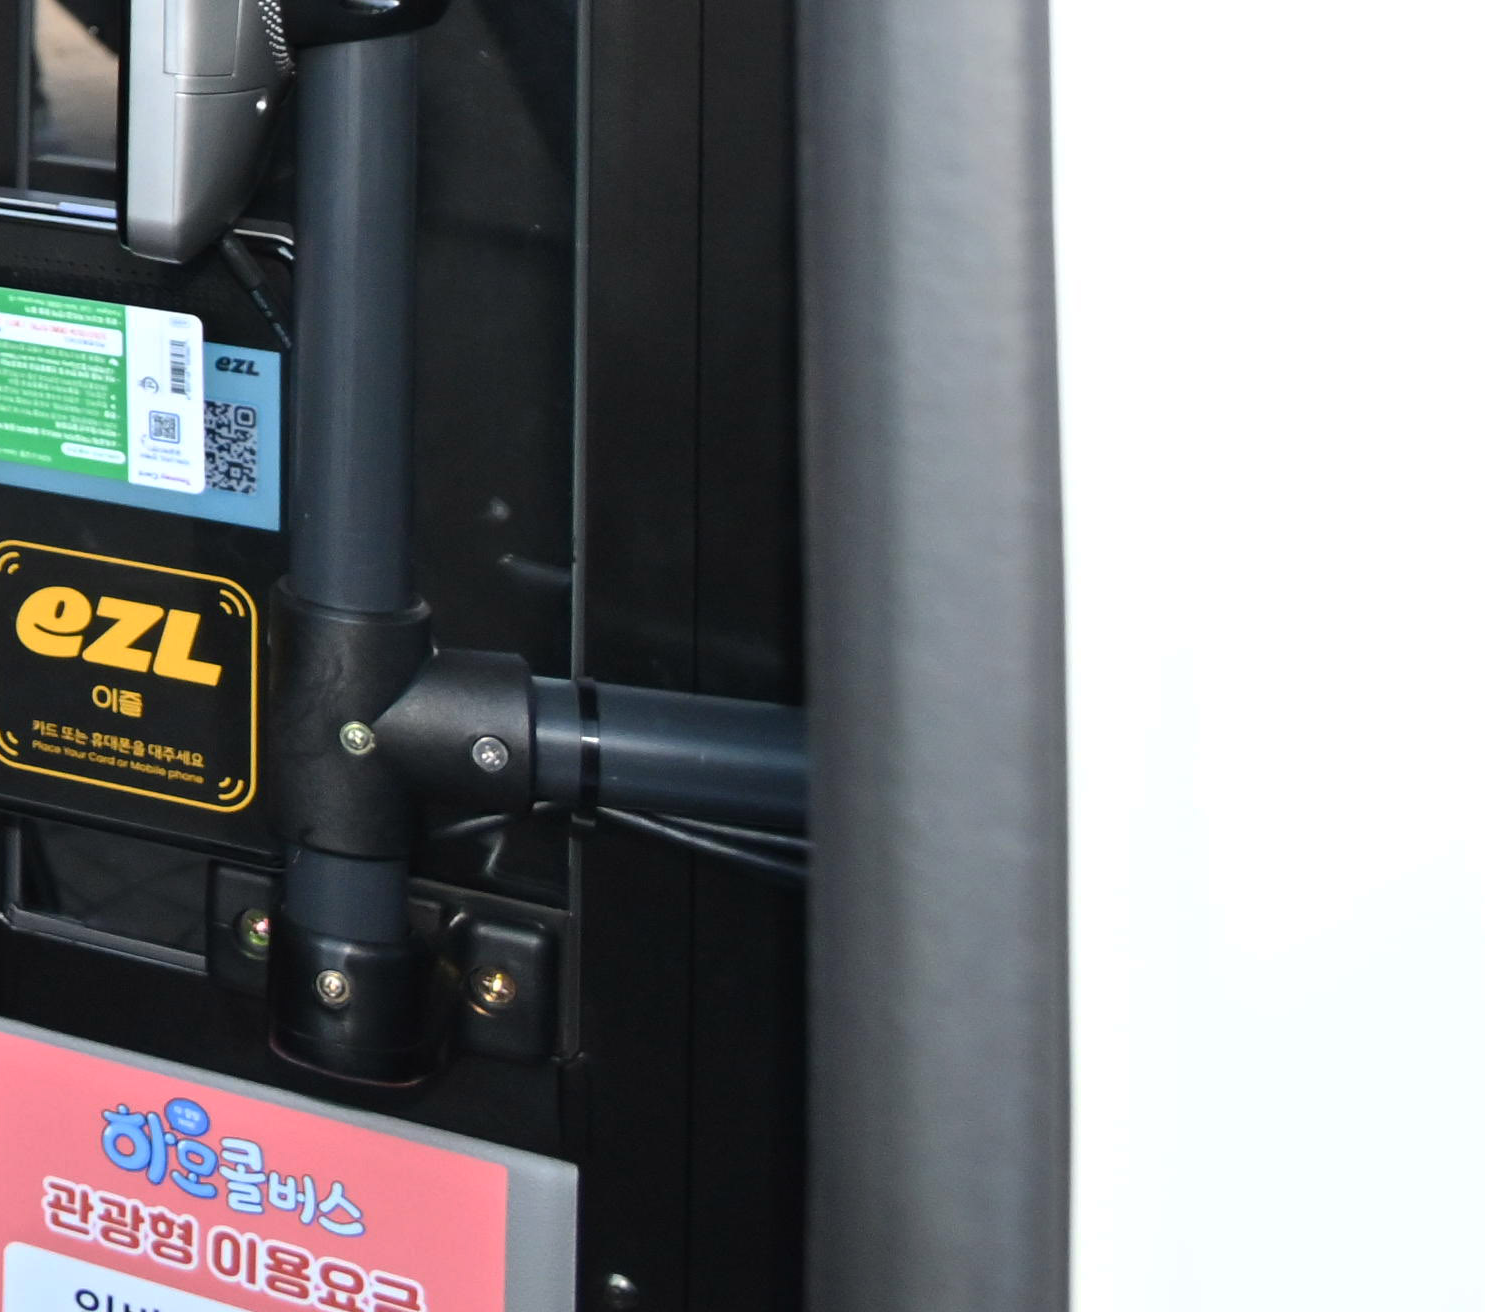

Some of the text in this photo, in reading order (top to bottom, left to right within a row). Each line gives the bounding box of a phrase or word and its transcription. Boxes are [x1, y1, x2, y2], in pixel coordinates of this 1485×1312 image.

[92, 685, 143, 718] 이즐
[32, 719, 205, 768] 카드 또는 휴대폰을 대주세요
[32, 739, 205, 784] Place Your Card or Mobile phone
[45, 1179, 197, 1267] 관광형
